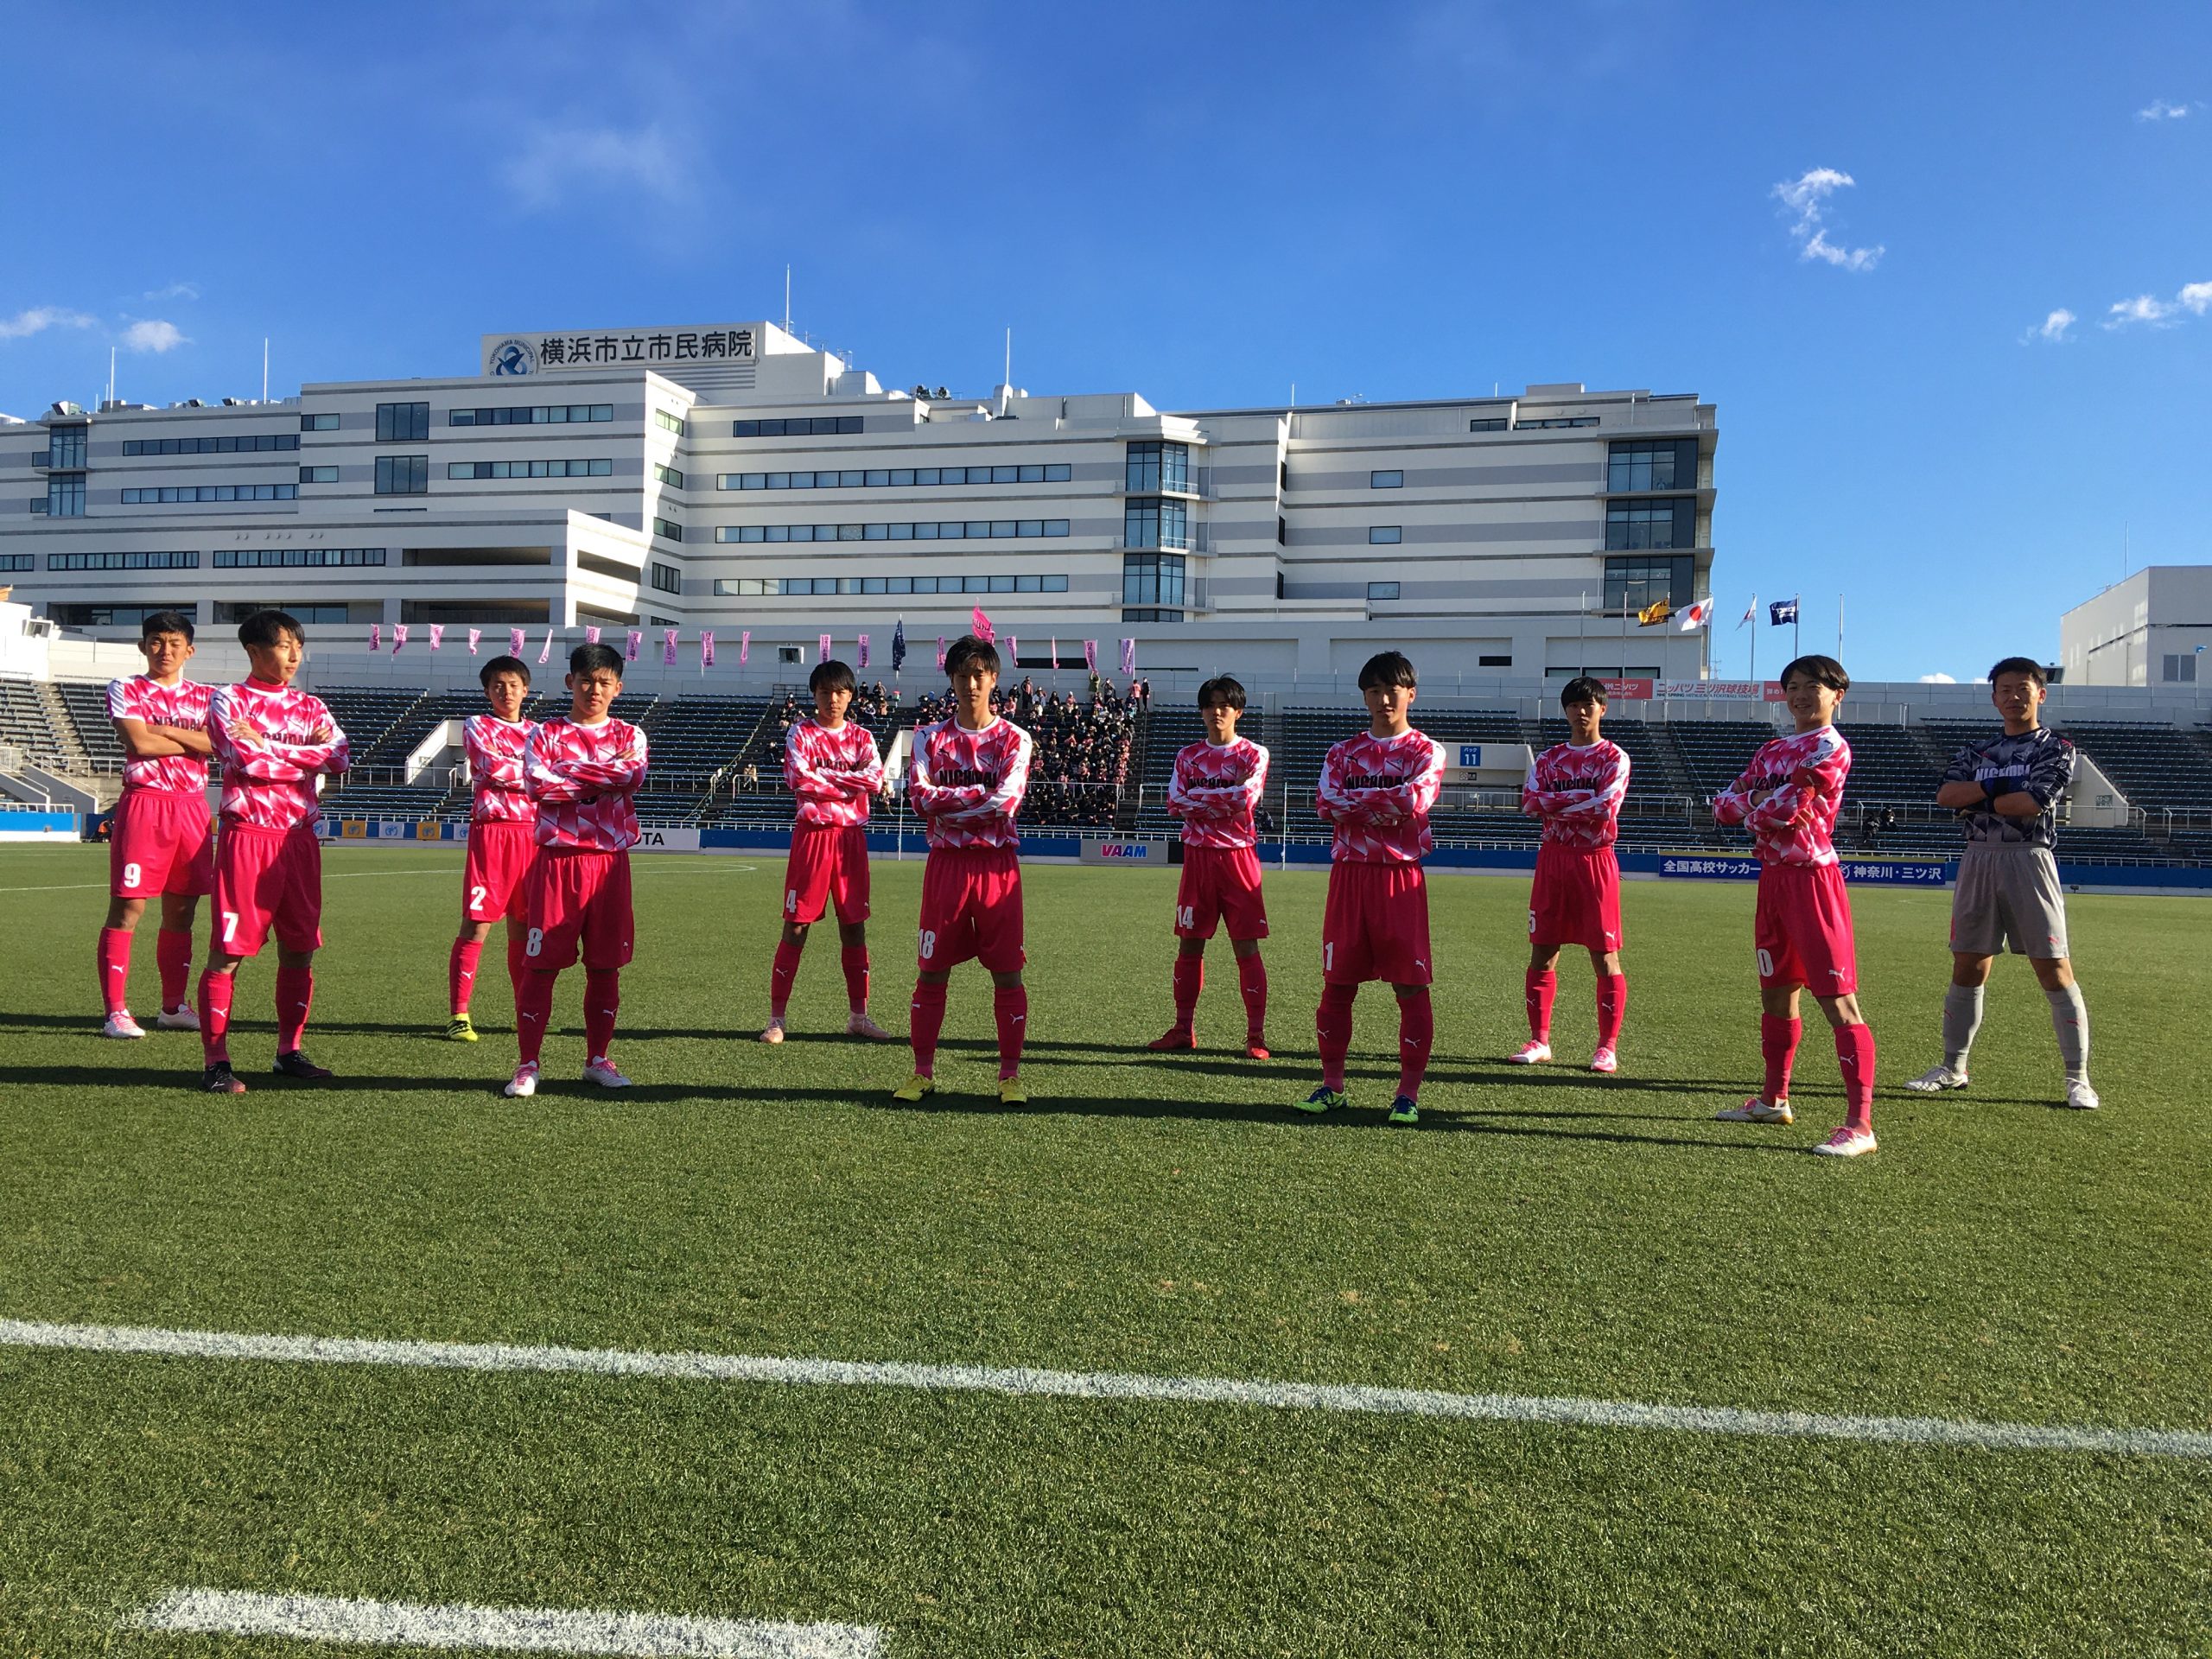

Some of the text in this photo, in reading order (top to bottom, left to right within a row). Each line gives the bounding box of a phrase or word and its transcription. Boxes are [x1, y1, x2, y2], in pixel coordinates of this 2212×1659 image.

[490, 339, 513, 365] YOKOHAMA
[540, 329, 753, 365] 横浜市立市民病院
[1465, 753, 1477, 766] 11
[635, 832, 665, 846] TA
[1101, 843, 1147, 858] VAAM
[124, 862, 142, 888] 9
[1663, 859, 1762, 874] 全国高校サッカー
[1853, 865, 1942, 880] 神奈川・三ツ沢
[469, 886, 486, 912] 2
[222, 911, 239, 943] 7
[1177, 905, 1195, 930] 14
[525, 927, 543, 957] 8
[918, 929, 937, 959] 18
